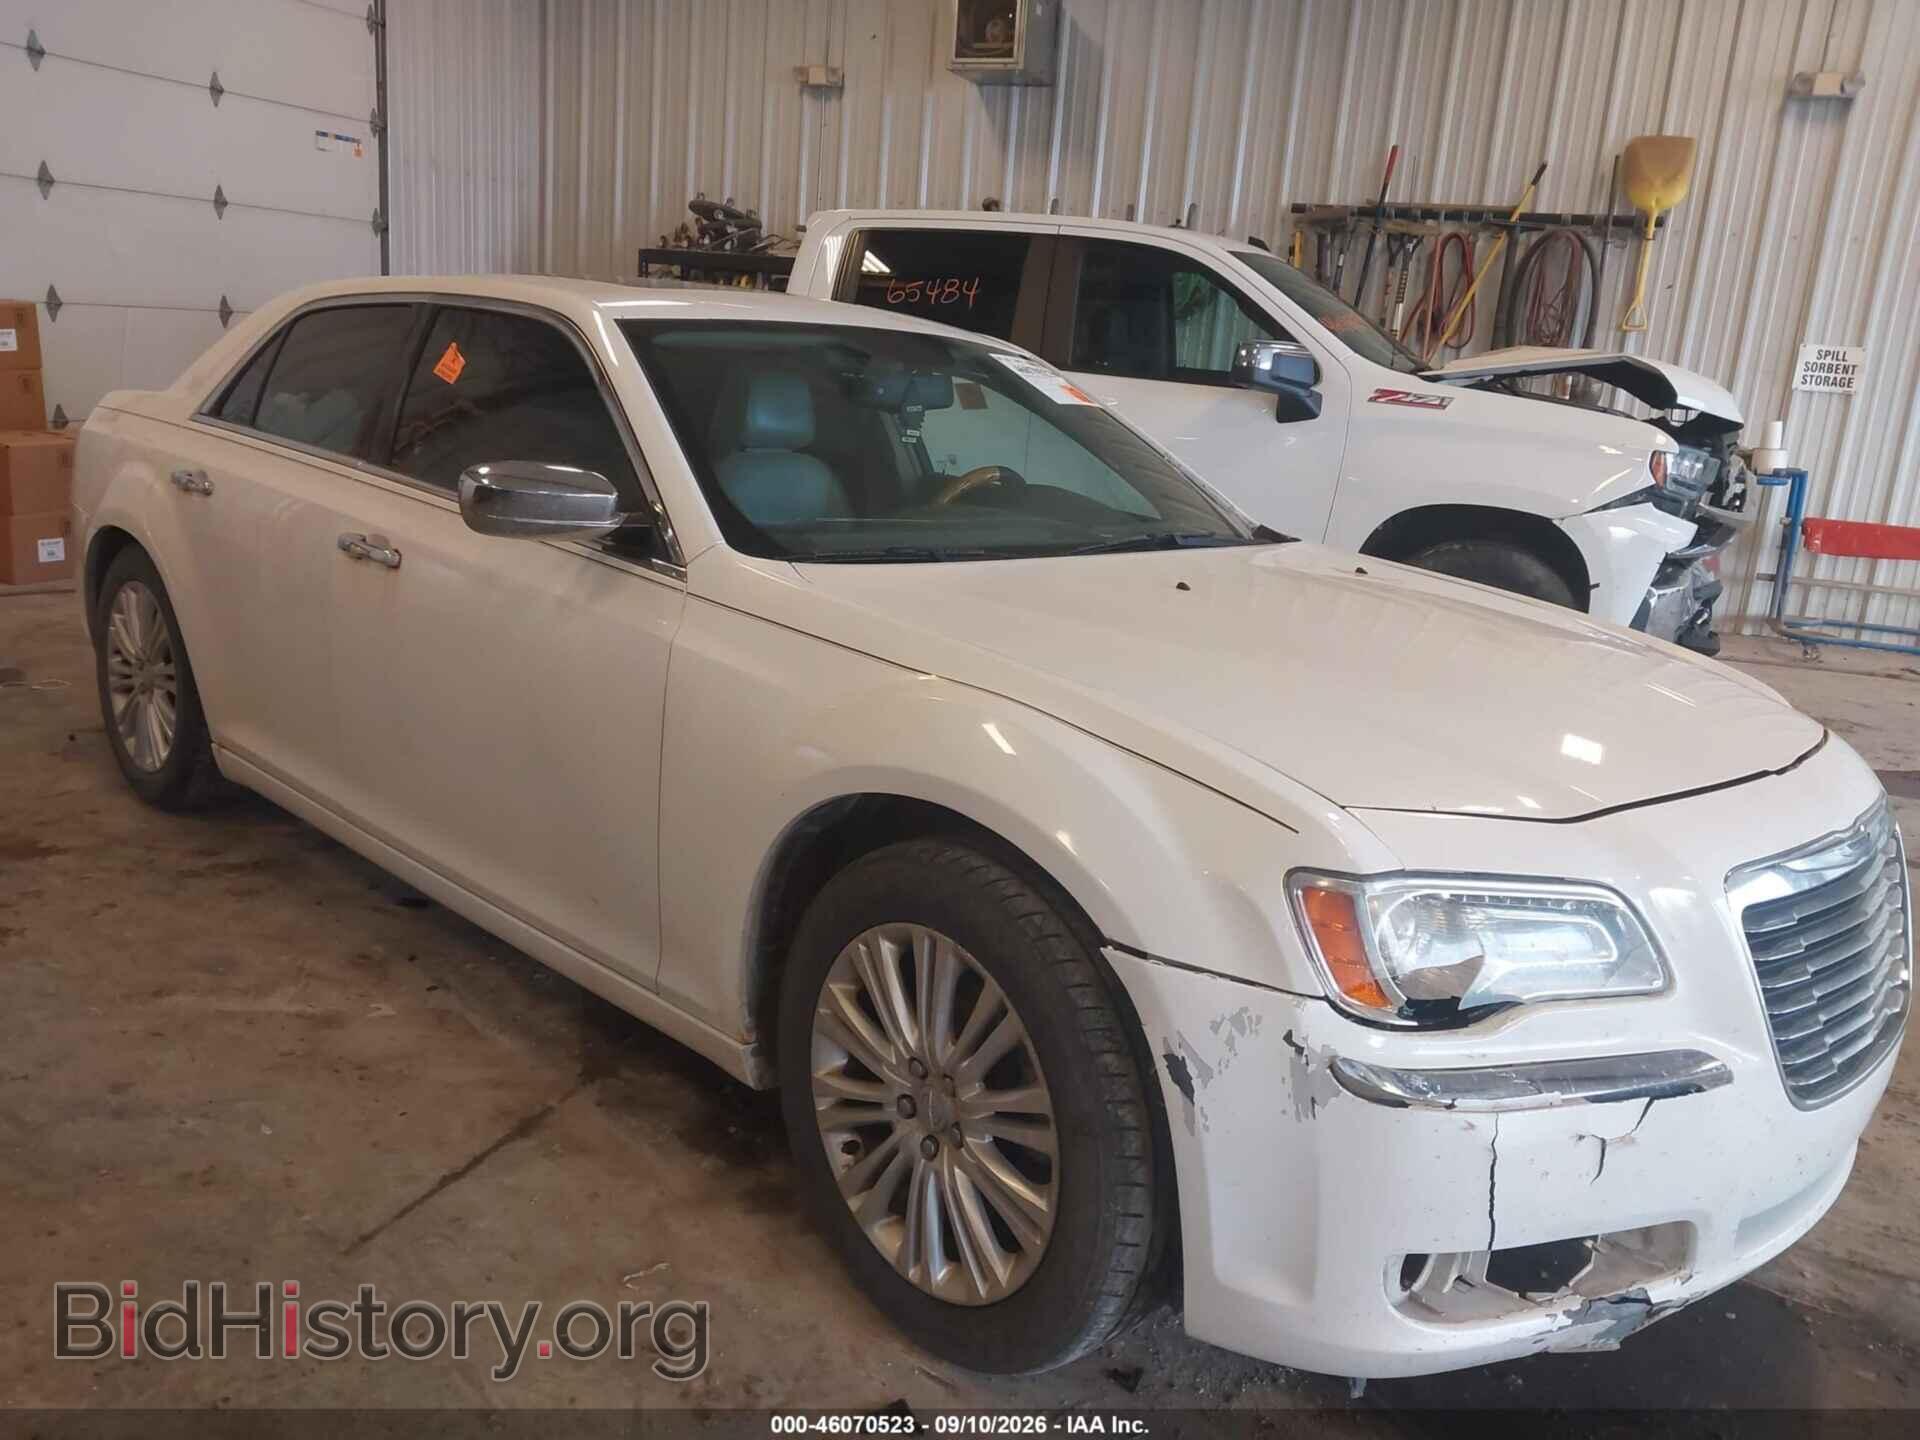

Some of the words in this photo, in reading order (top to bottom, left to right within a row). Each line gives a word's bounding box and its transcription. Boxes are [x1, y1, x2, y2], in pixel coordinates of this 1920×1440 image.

[887, 278, 981, 311] 65484
[1816, 348, 1848, 363] SPILL
[1803, 361, 1858, 376] SORBENT
[1801, 374, 1855, 389] STORAGE
